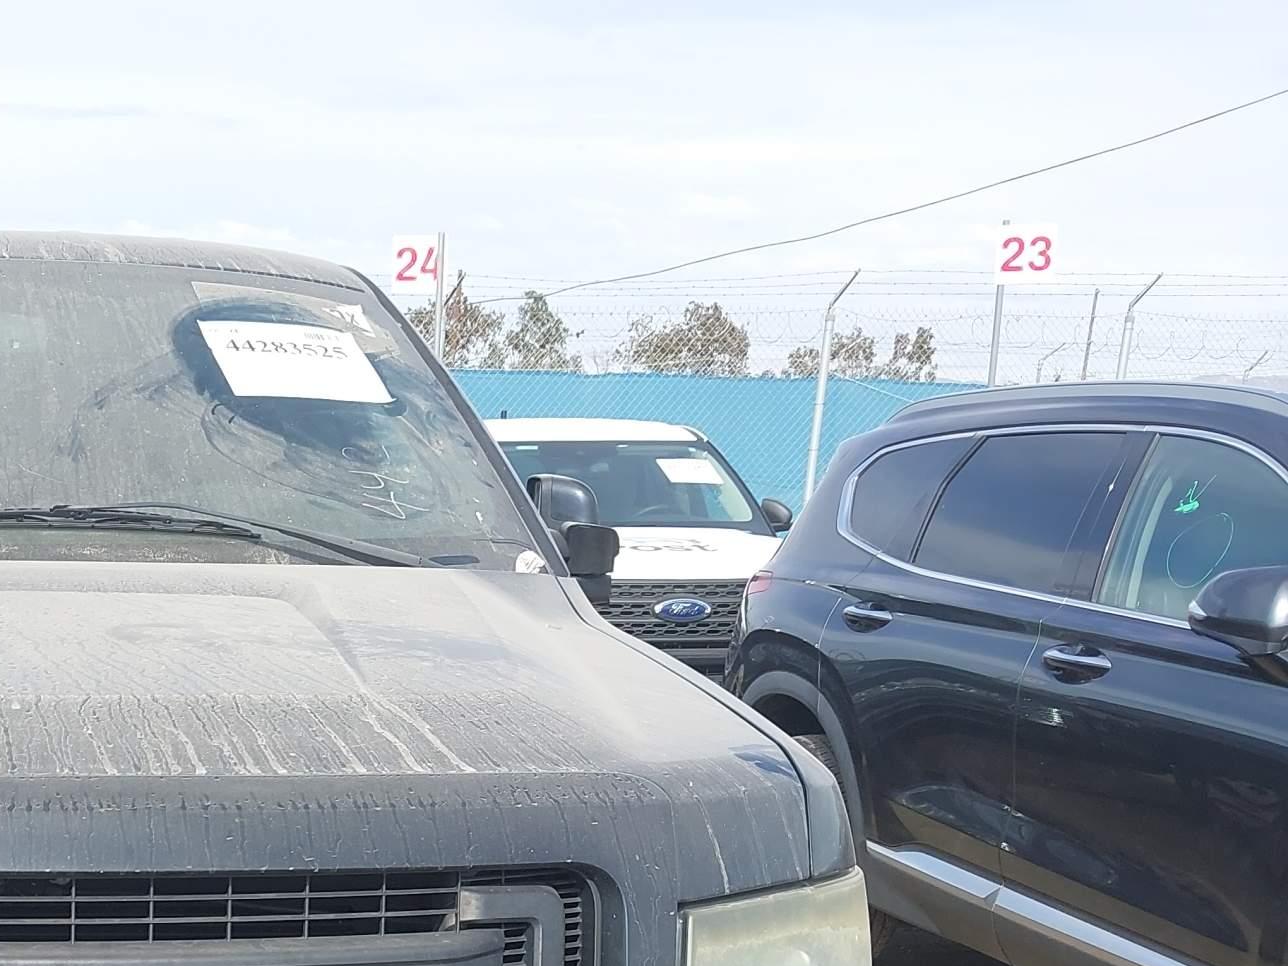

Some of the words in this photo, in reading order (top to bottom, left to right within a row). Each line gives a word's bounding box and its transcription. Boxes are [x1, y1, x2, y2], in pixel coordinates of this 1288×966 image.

[396, 247, 438, 281] 24
[1001, 236, 1052, 271] 23
[225, 338, 349, 360] 44283525
